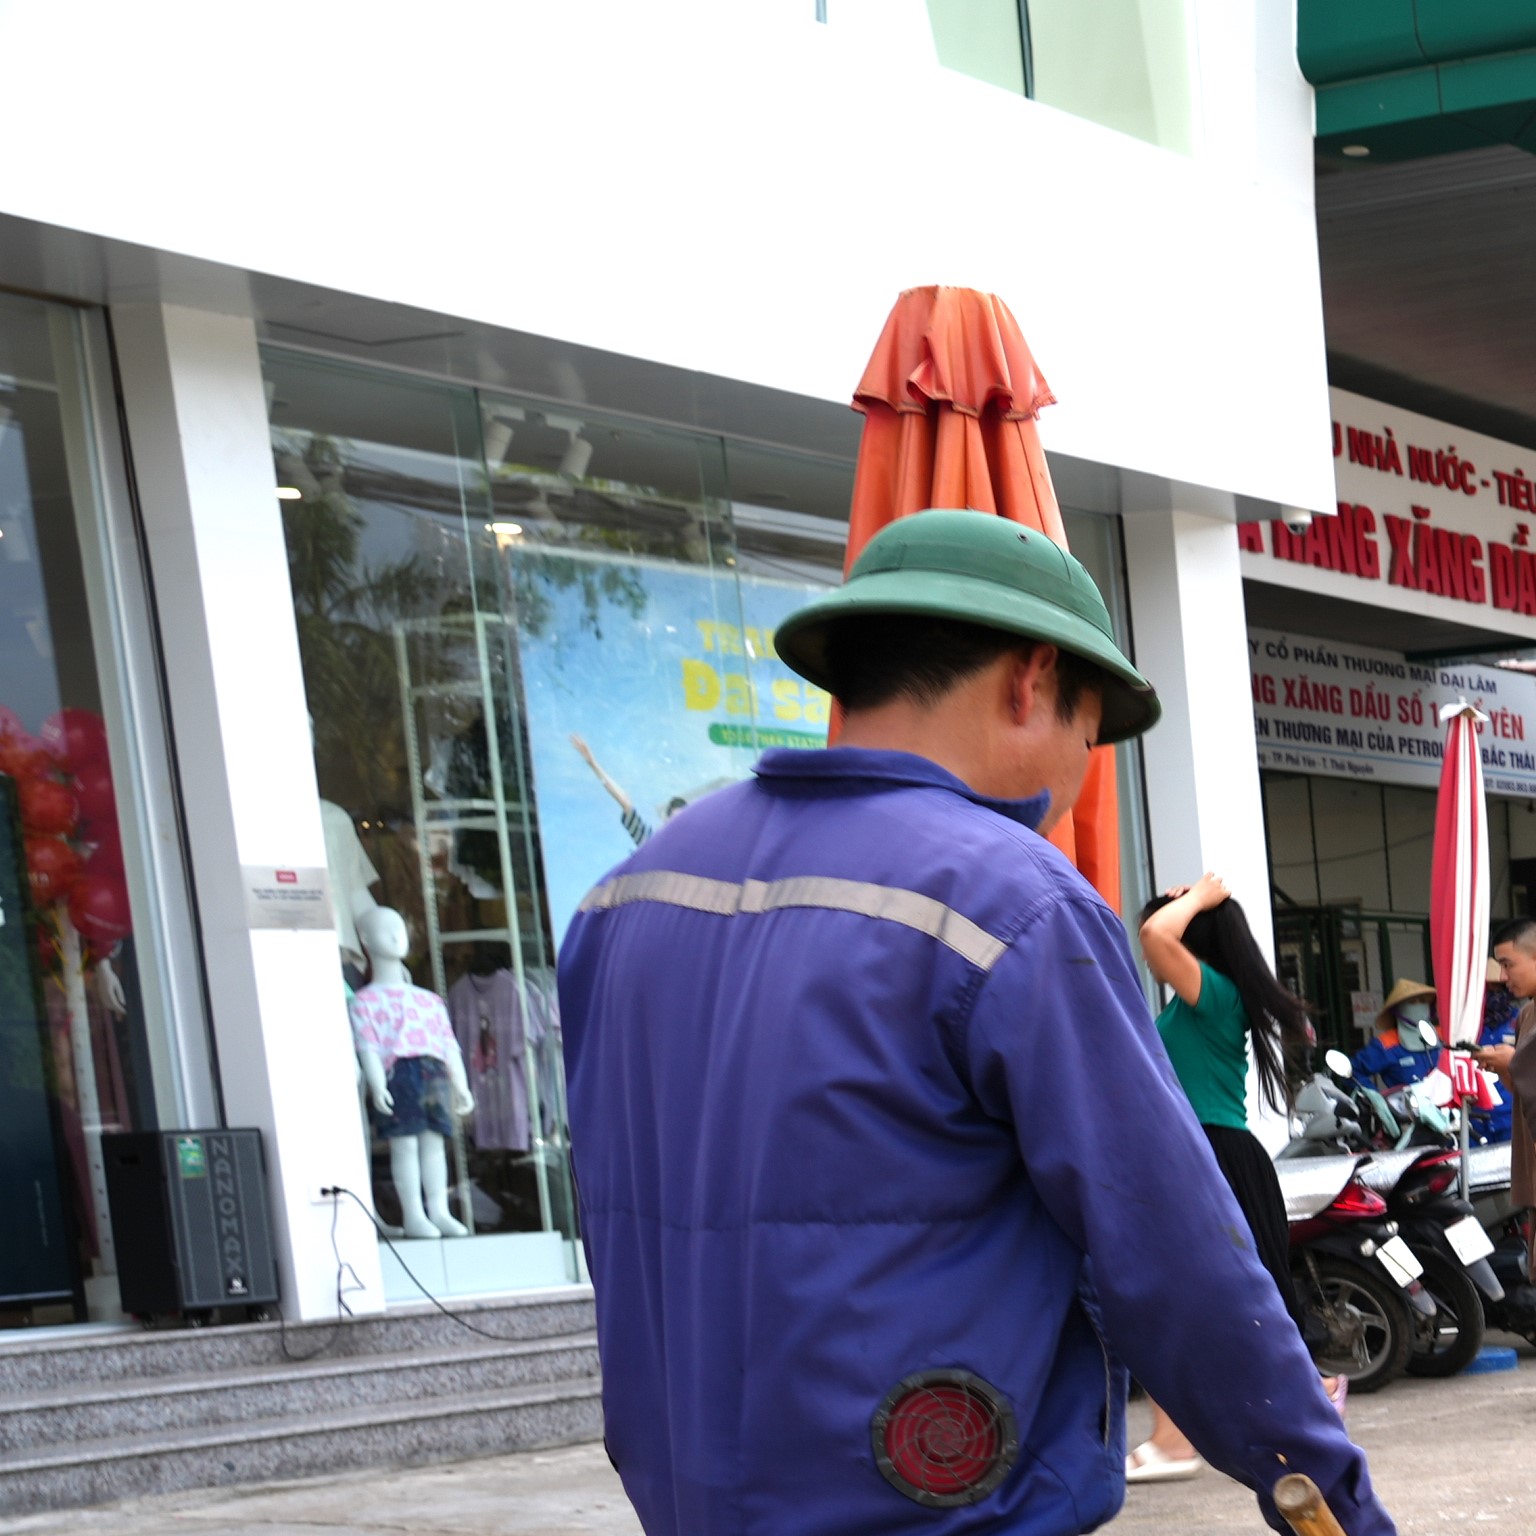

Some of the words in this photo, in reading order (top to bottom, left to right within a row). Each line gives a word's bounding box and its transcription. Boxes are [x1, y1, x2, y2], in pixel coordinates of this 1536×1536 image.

[1347, 426, 1403, 477] NHÀ
[1407, 446, 1477, 496] NƯỚC
[1383, 504, 1487, 604] XĂNG
[1282, 673, 1344, 716] XĂNG
[1349, 680, 1392, 722] DẦU
[1396, 687, 1424, 727] SỐ
[1429, 701, 1440, 729] 1
[1409, 666, 1437, 688] MẠI
[1488, 703, 1526, 742] YÊN
